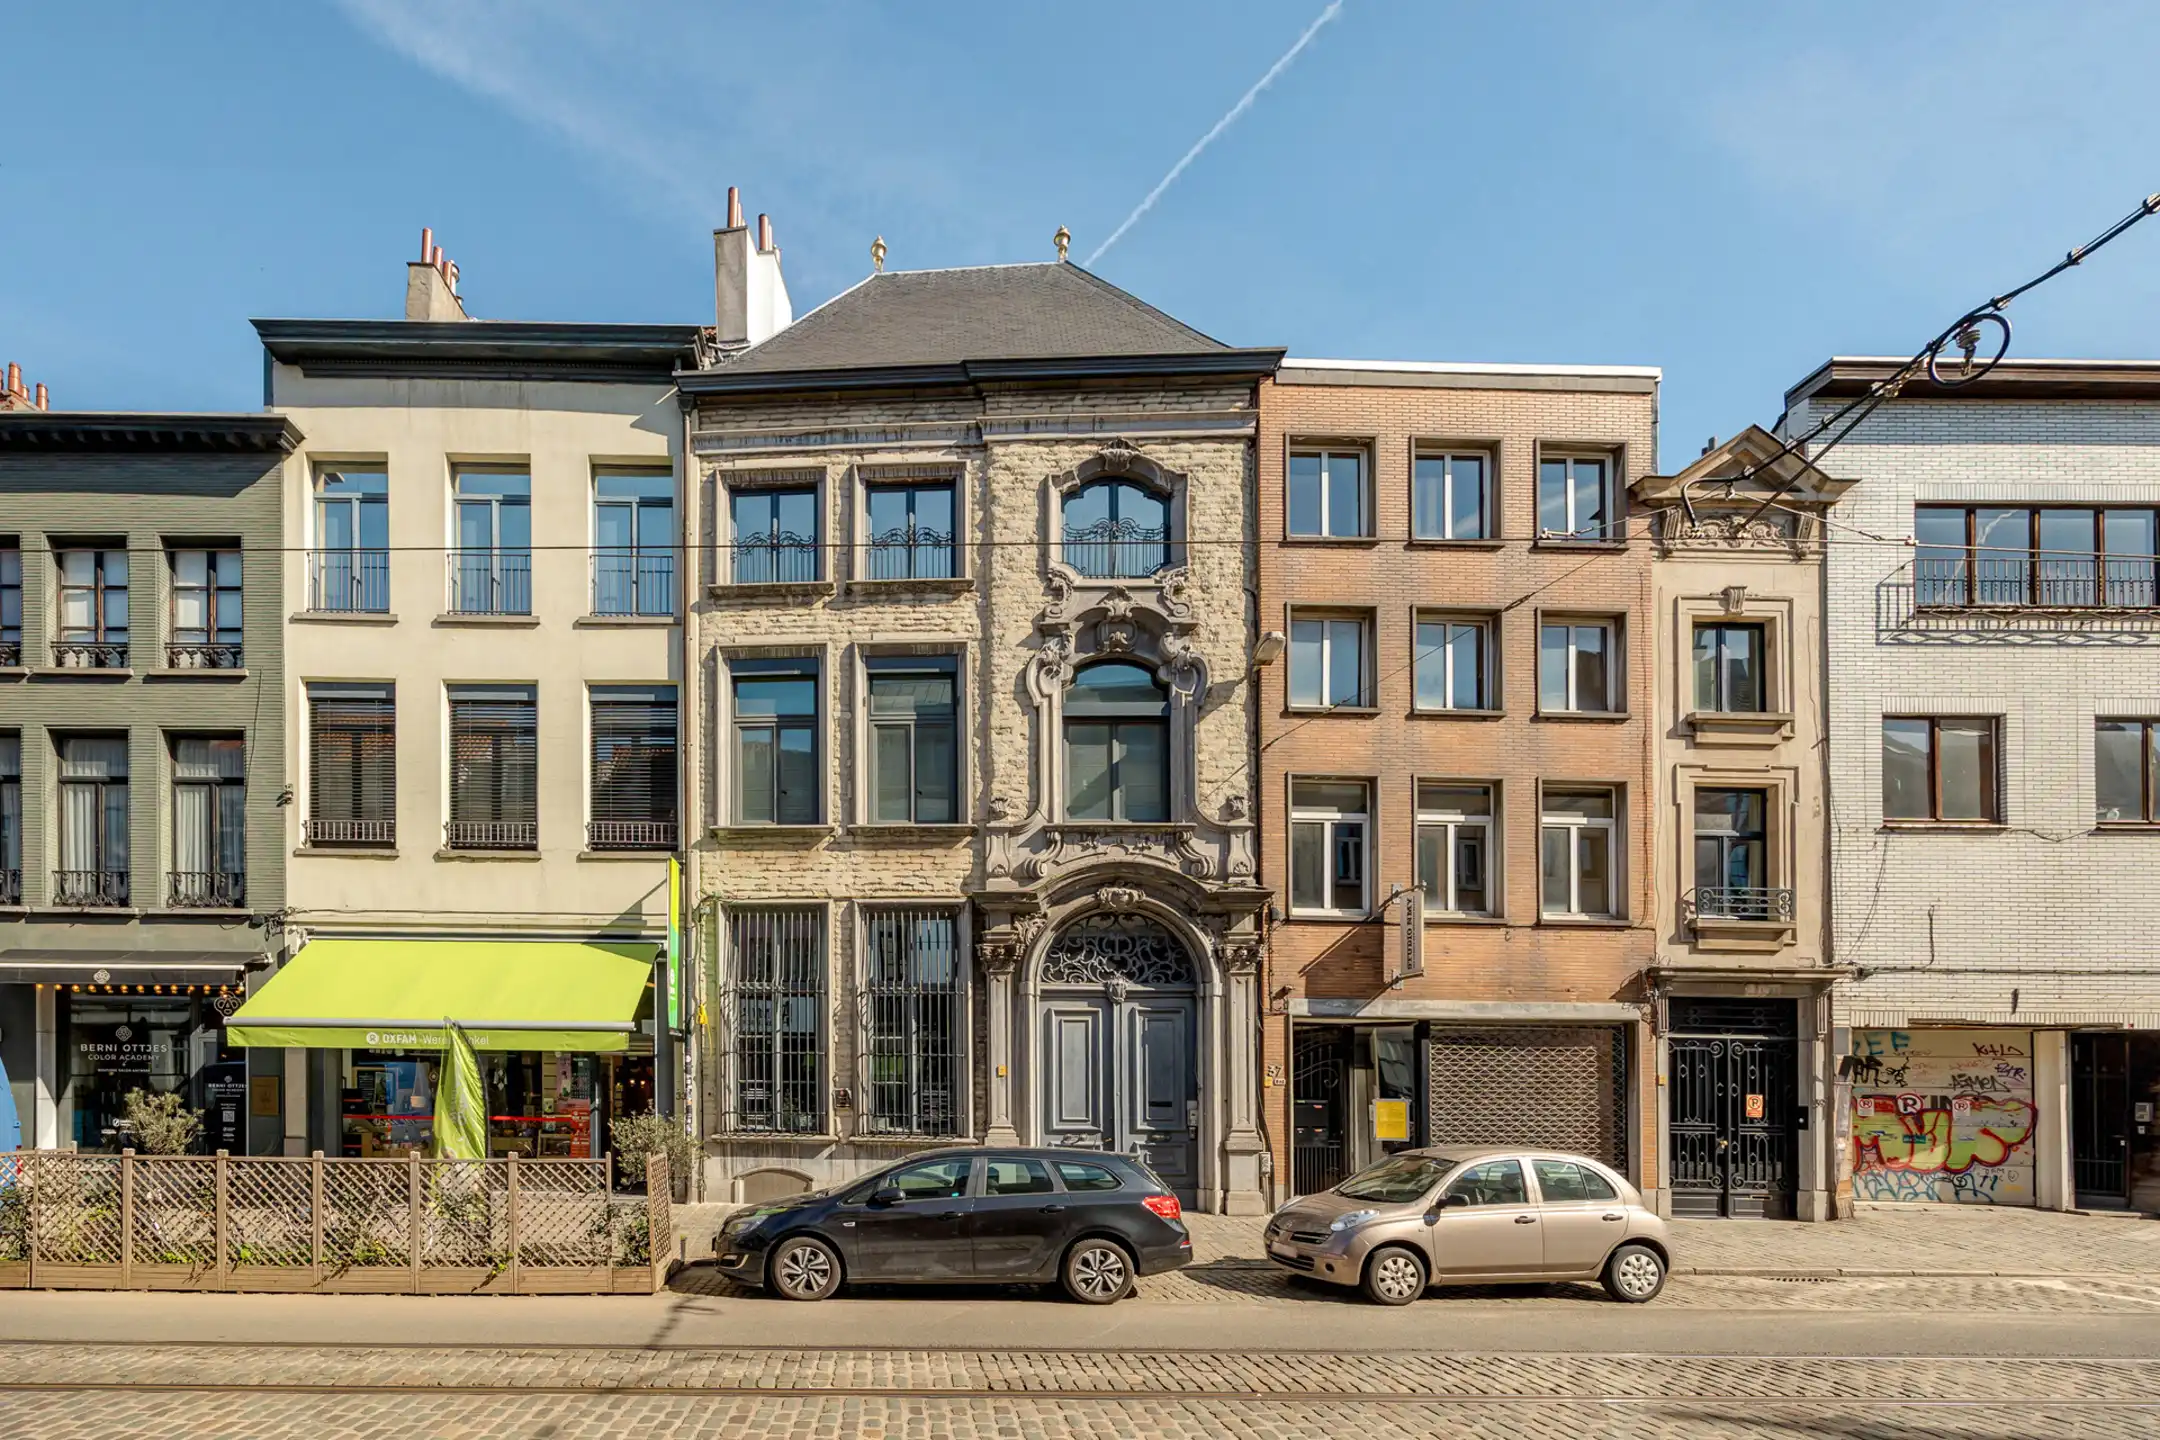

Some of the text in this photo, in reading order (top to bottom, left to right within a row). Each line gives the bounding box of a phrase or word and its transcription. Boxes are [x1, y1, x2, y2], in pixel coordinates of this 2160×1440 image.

[382, 1033, 417, 1044] OXFAM
[80, 1043, 168, 1053] BERNI OTTJES
[87, 1053, 117, 1061] COLOR
